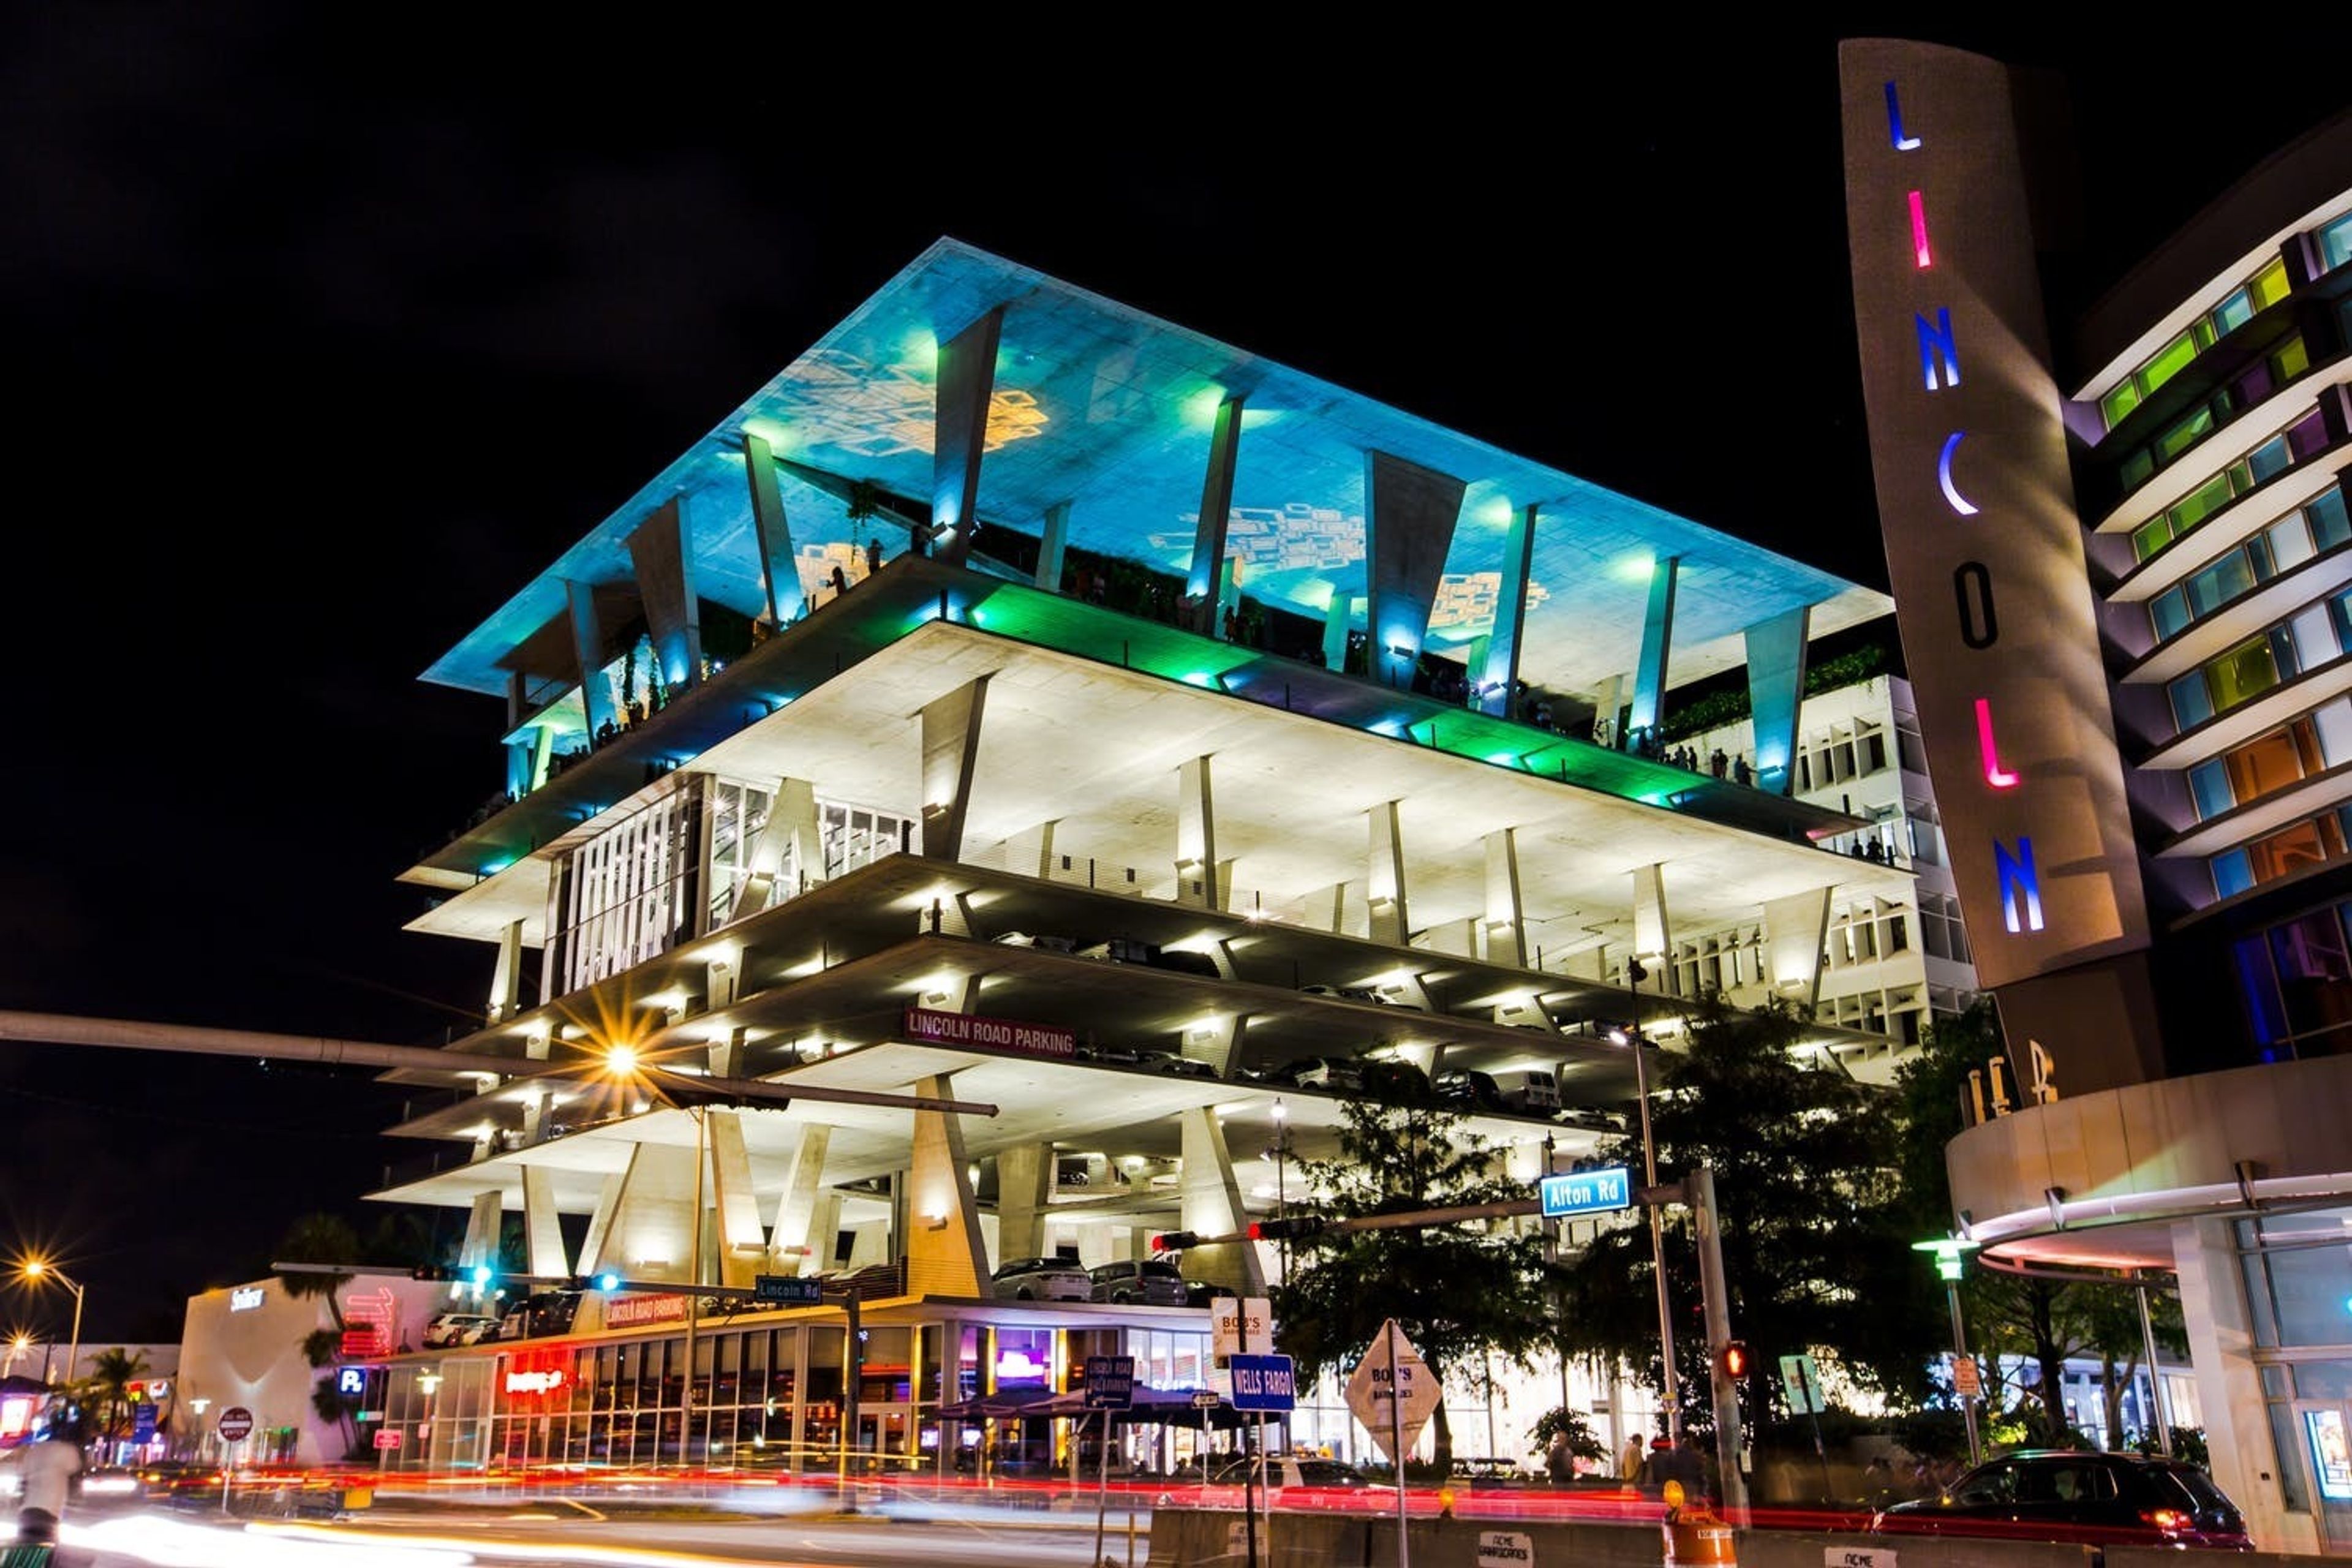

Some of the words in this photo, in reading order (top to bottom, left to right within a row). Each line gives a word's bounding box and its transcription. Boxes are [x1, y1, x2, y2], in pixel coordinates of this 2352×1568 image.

[1884, 80, 2046, 933] LINCOLN
[909, 1012, 970, 1039] LINCOLN
[973, 1022, 1012, 1044] ROAD
[1015, 1028, 1073, 1054] PARKING
[1550, 1184, 1592, 1208] Alton
[1597, 1178, 1619, 1202] Rd
[760, 1283, 801, 1296] Lincoln
[804, 1284, 818, 1298] Rd
[1234, 1368, 1262, 1395] WELLS
[1264, 1370, 1292, 1396] FARGO
[1372, 1367, 1412, 1382] BO'S
